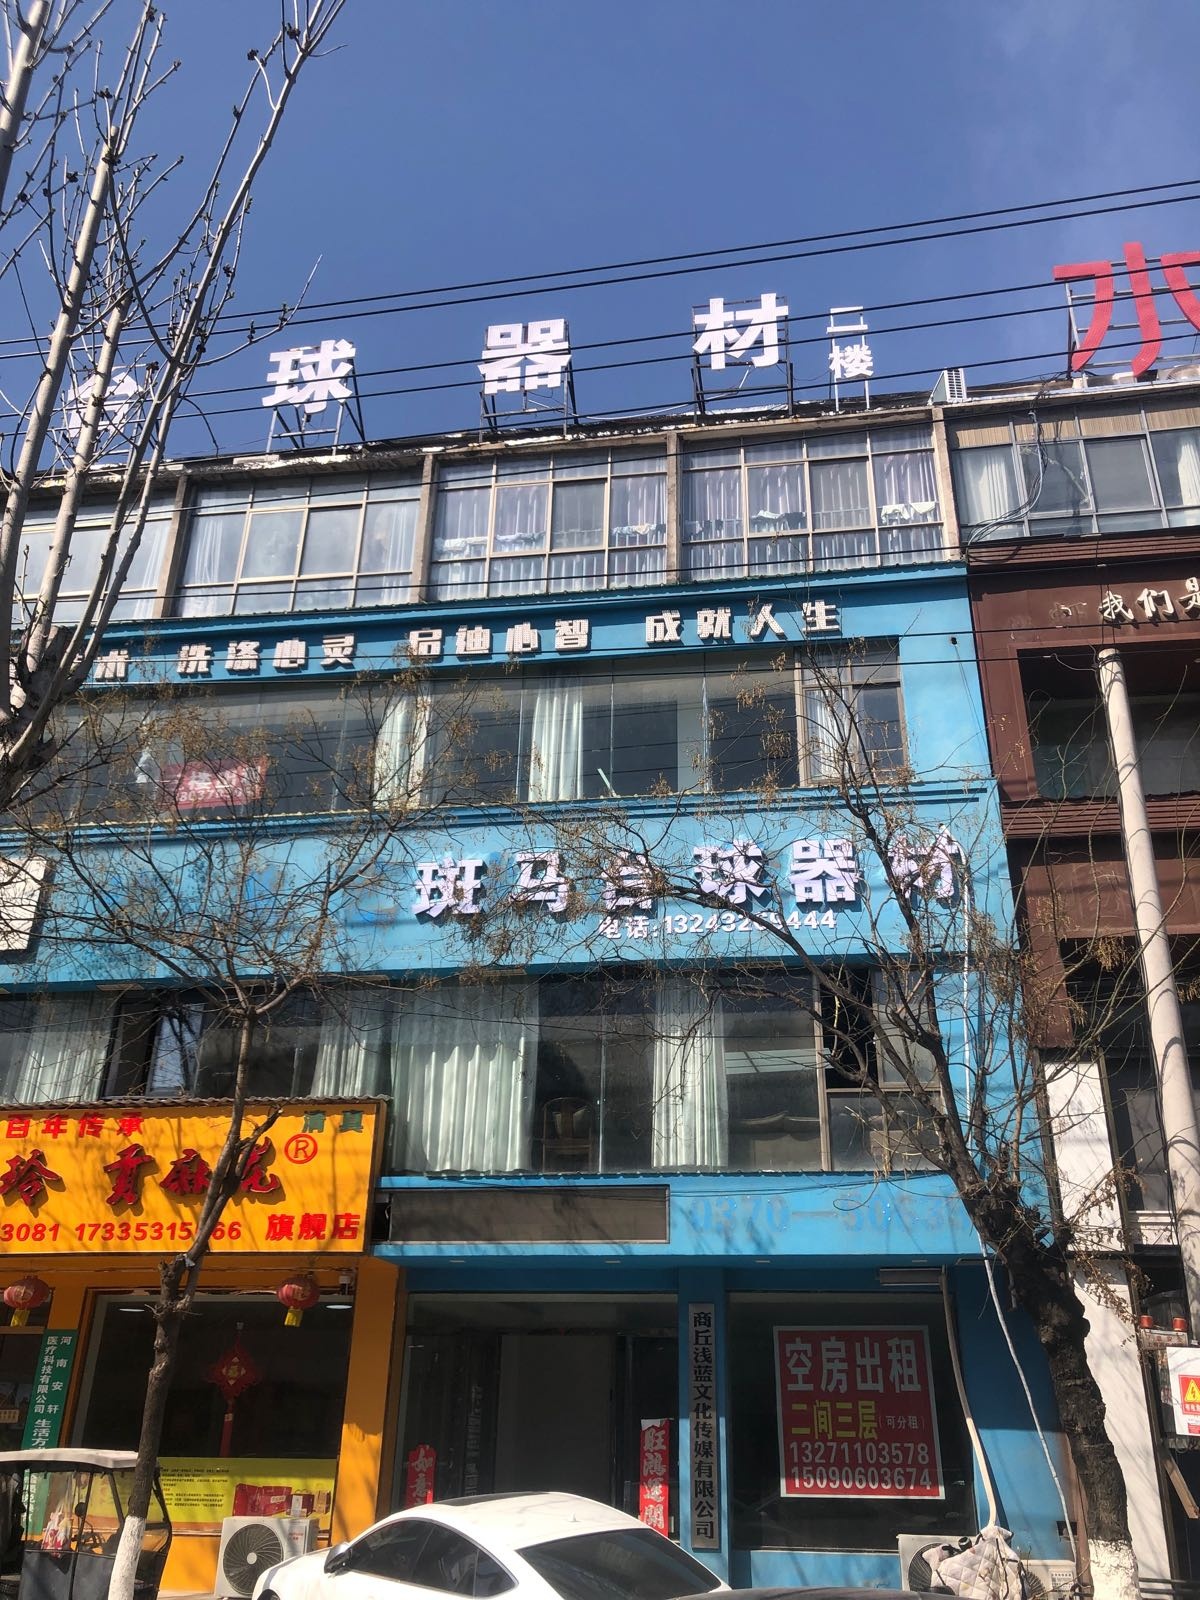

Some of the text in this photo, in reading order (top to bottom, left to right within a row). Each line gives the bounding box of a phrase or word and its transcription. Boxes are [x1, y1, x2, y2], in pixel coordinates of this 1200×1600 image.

[827, 306, 874, 378] 二楼
[177, 633, 356, 677] 洗涤心灵
[408, 618, 590, 656] 启迪心智
[645, 600, 841, 643] 成就人生
[6, 1112, 144, 1140] 百年传承
[0, 1213, 361, 1243] 3081 1733531566 旗舰店
[34, 1336, 58, 1414] 医疗科技有限公司
[46, 1336, 73, 1415] 河南安轩
[785, 1336, 921, 1393] 空房出租
[31, 1419, 52, 1450] 生活方
[692, 1311, 715, 1540] 商丘浅蓝文化传媒有限公司
[791, 1399, 879, 1440] 二间三层
[409, 1447, 434, 1505] 如意
[790, 1442, 930, 1465] 13271103578
[792, 1466, 932, 1490] 15090603674
